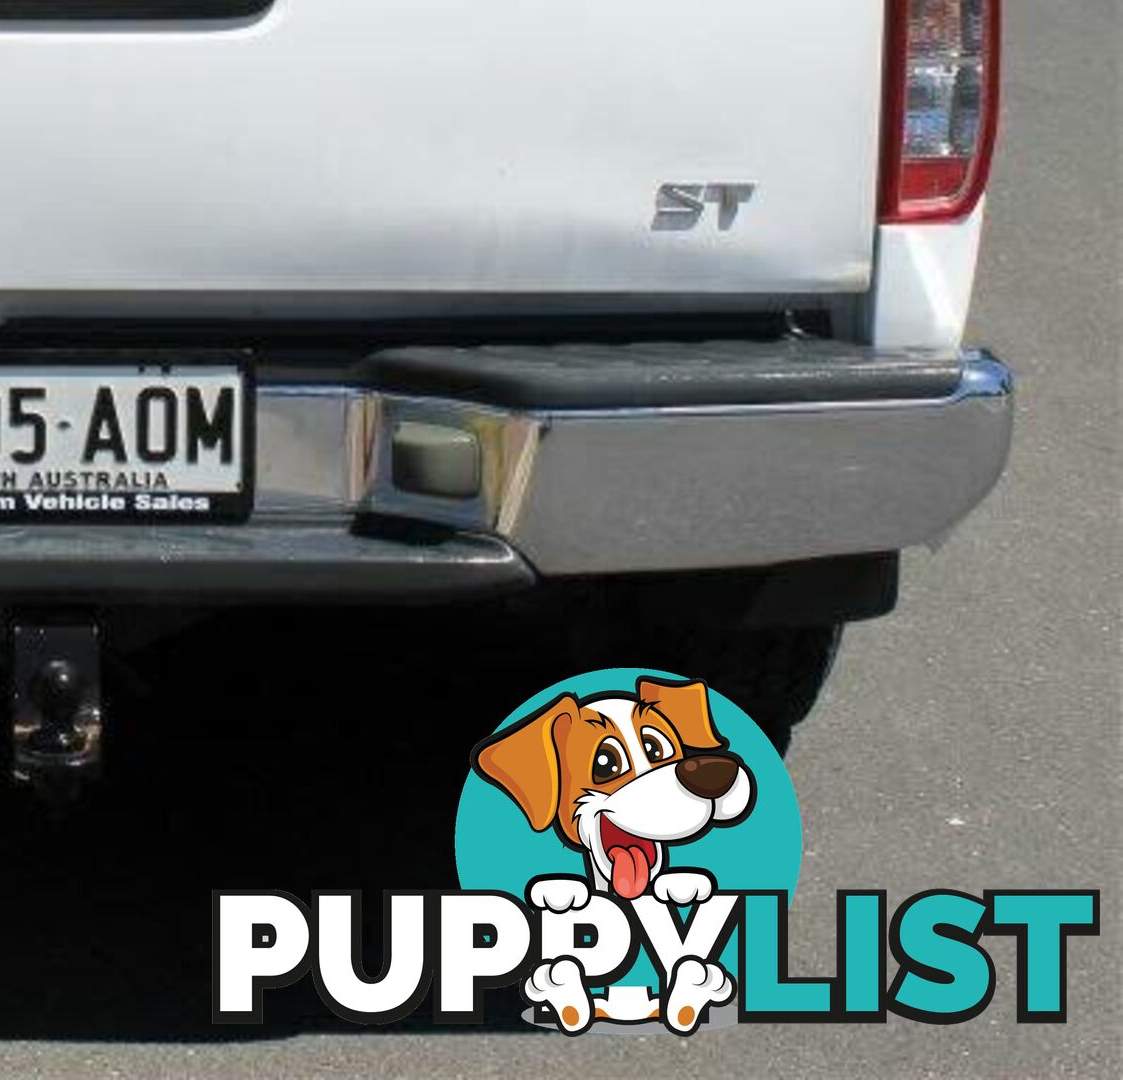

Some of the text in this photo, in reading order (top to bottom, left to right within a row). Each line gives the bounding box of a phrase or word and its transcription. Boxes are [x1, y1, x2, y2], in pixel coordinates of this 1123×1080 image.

[651, 182, 756, 231] ST
[29, 471, 170, 490] AUSTRALIA
[25, 494, 126, 512] Vehicle
[134, 494, 211, 512] Sales
